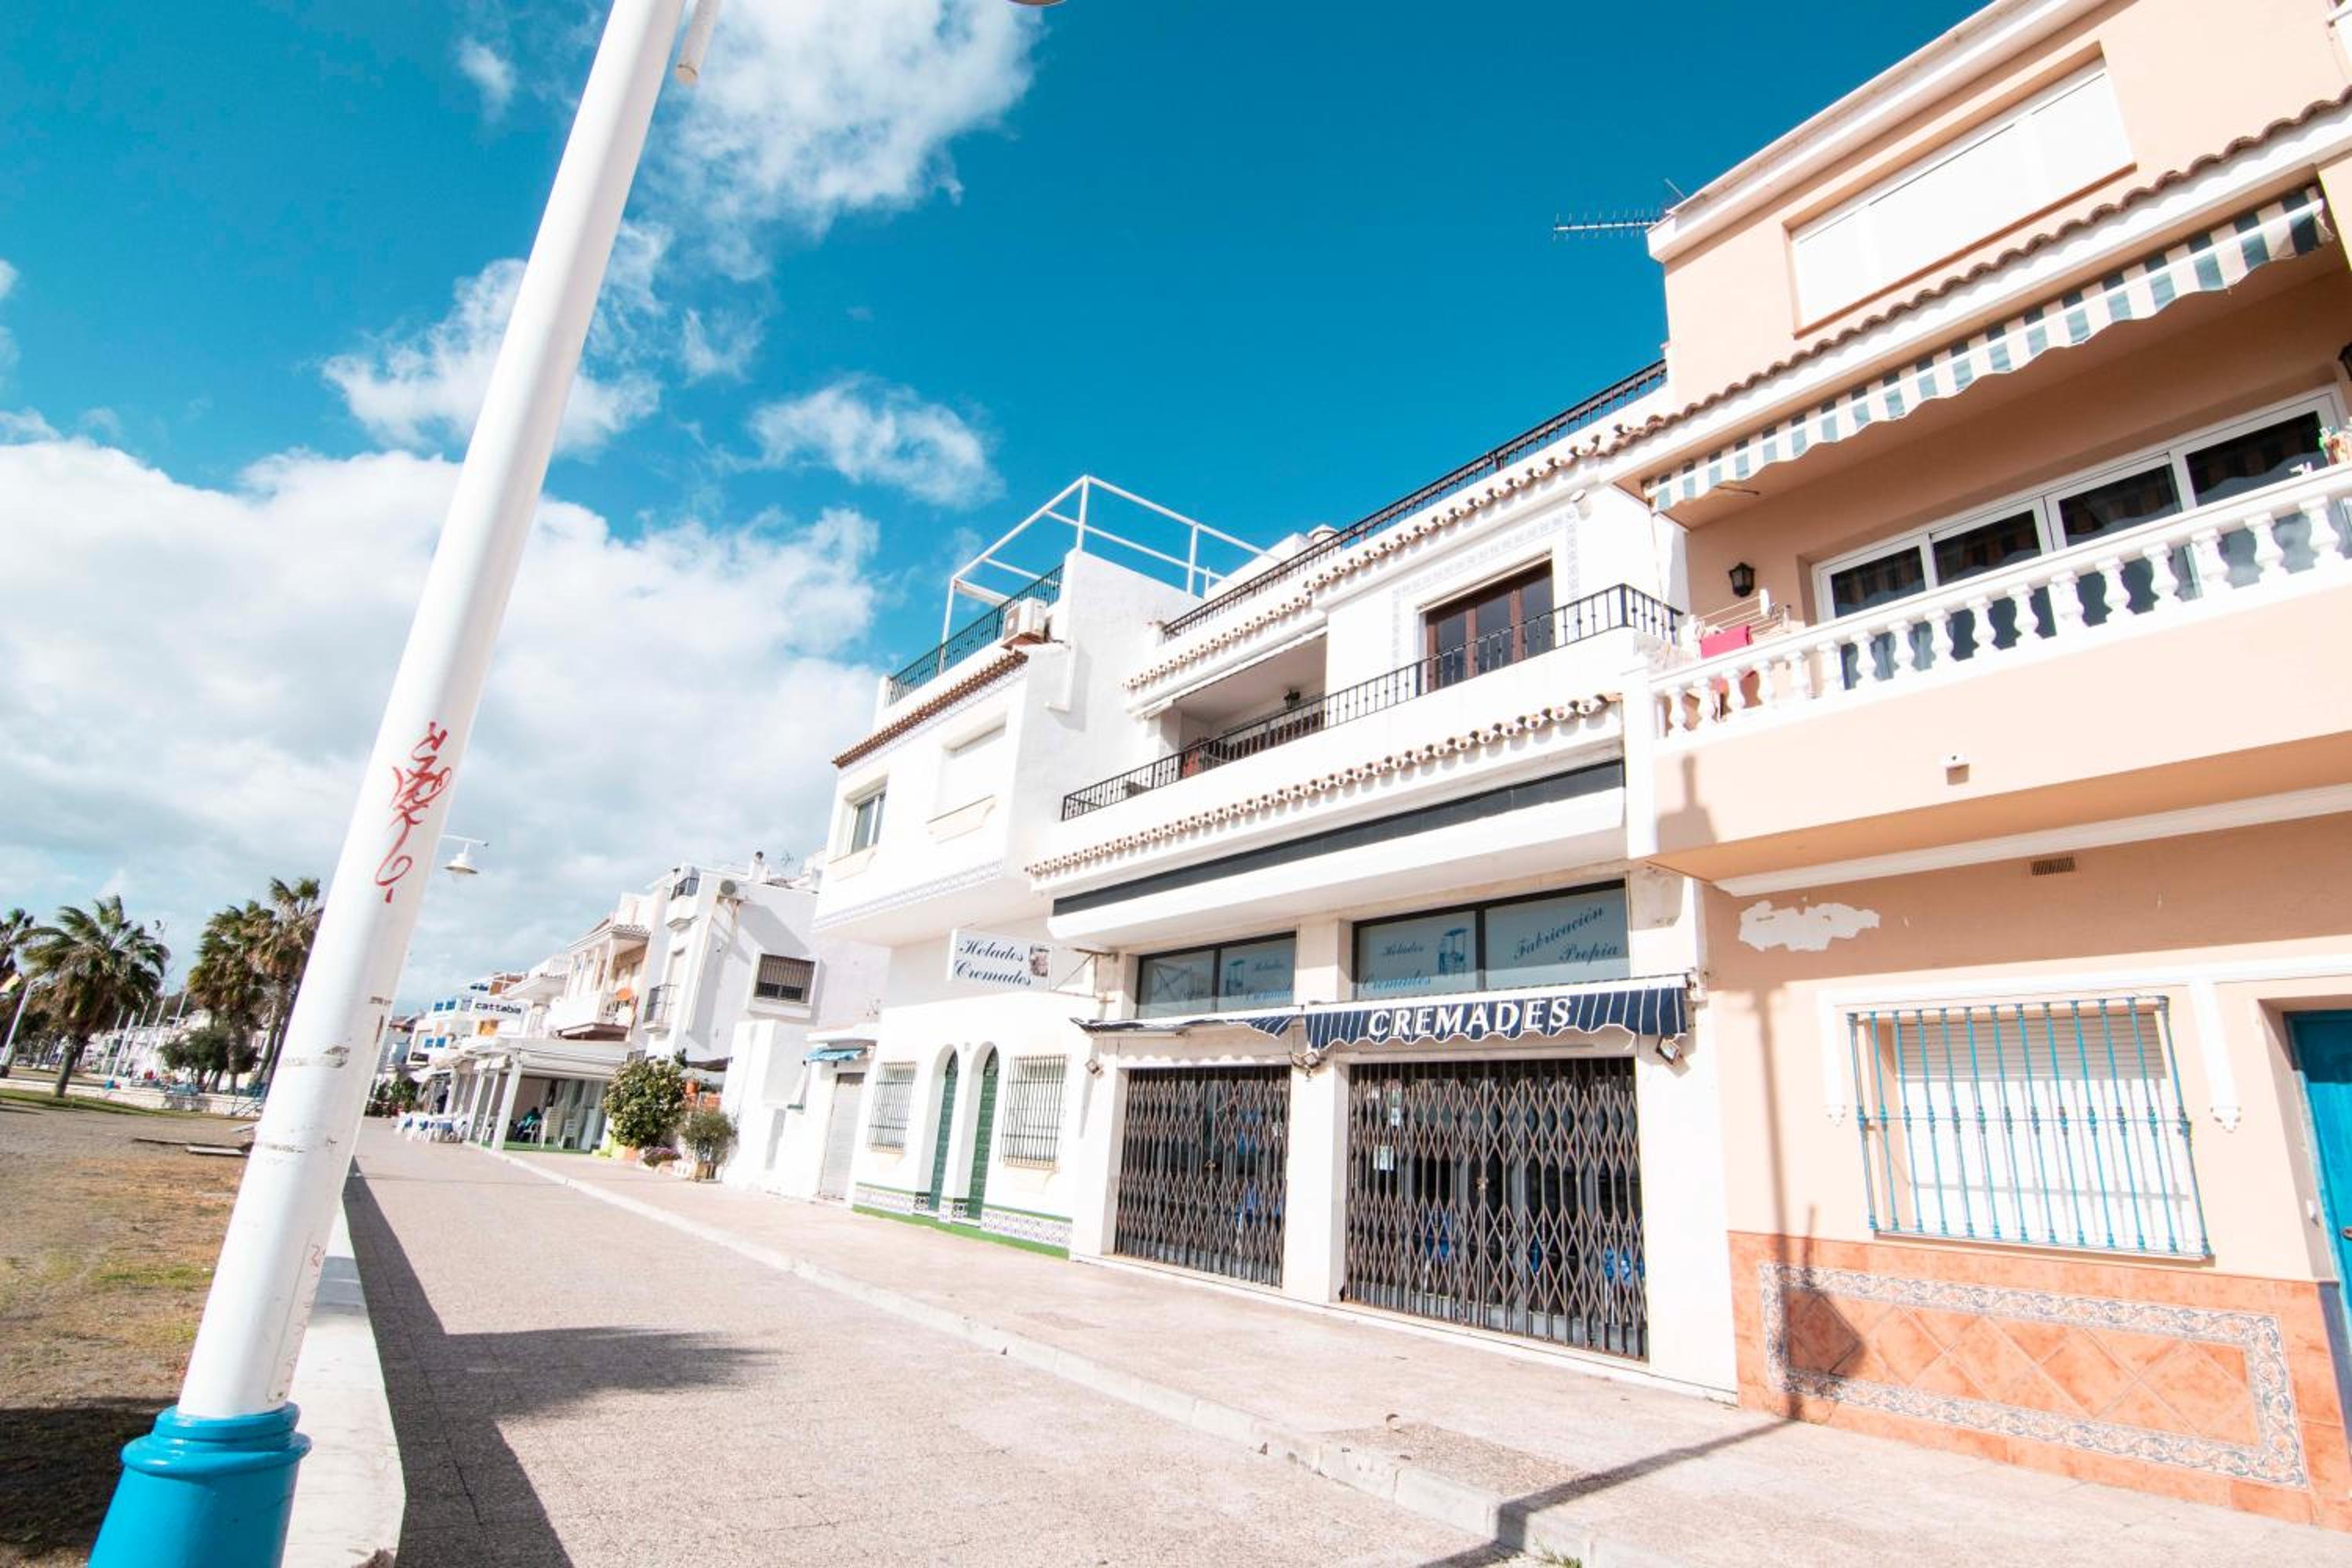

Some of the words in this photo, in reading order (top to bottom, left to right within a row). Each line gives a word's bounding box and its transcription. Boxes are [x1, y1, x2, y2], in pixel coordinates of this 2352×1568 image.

[959, 940, 1024, 962] Helados
[1513, 906, 1604, 961] Fabricación
[1369, 998, 1572, 1036] CREMADES
